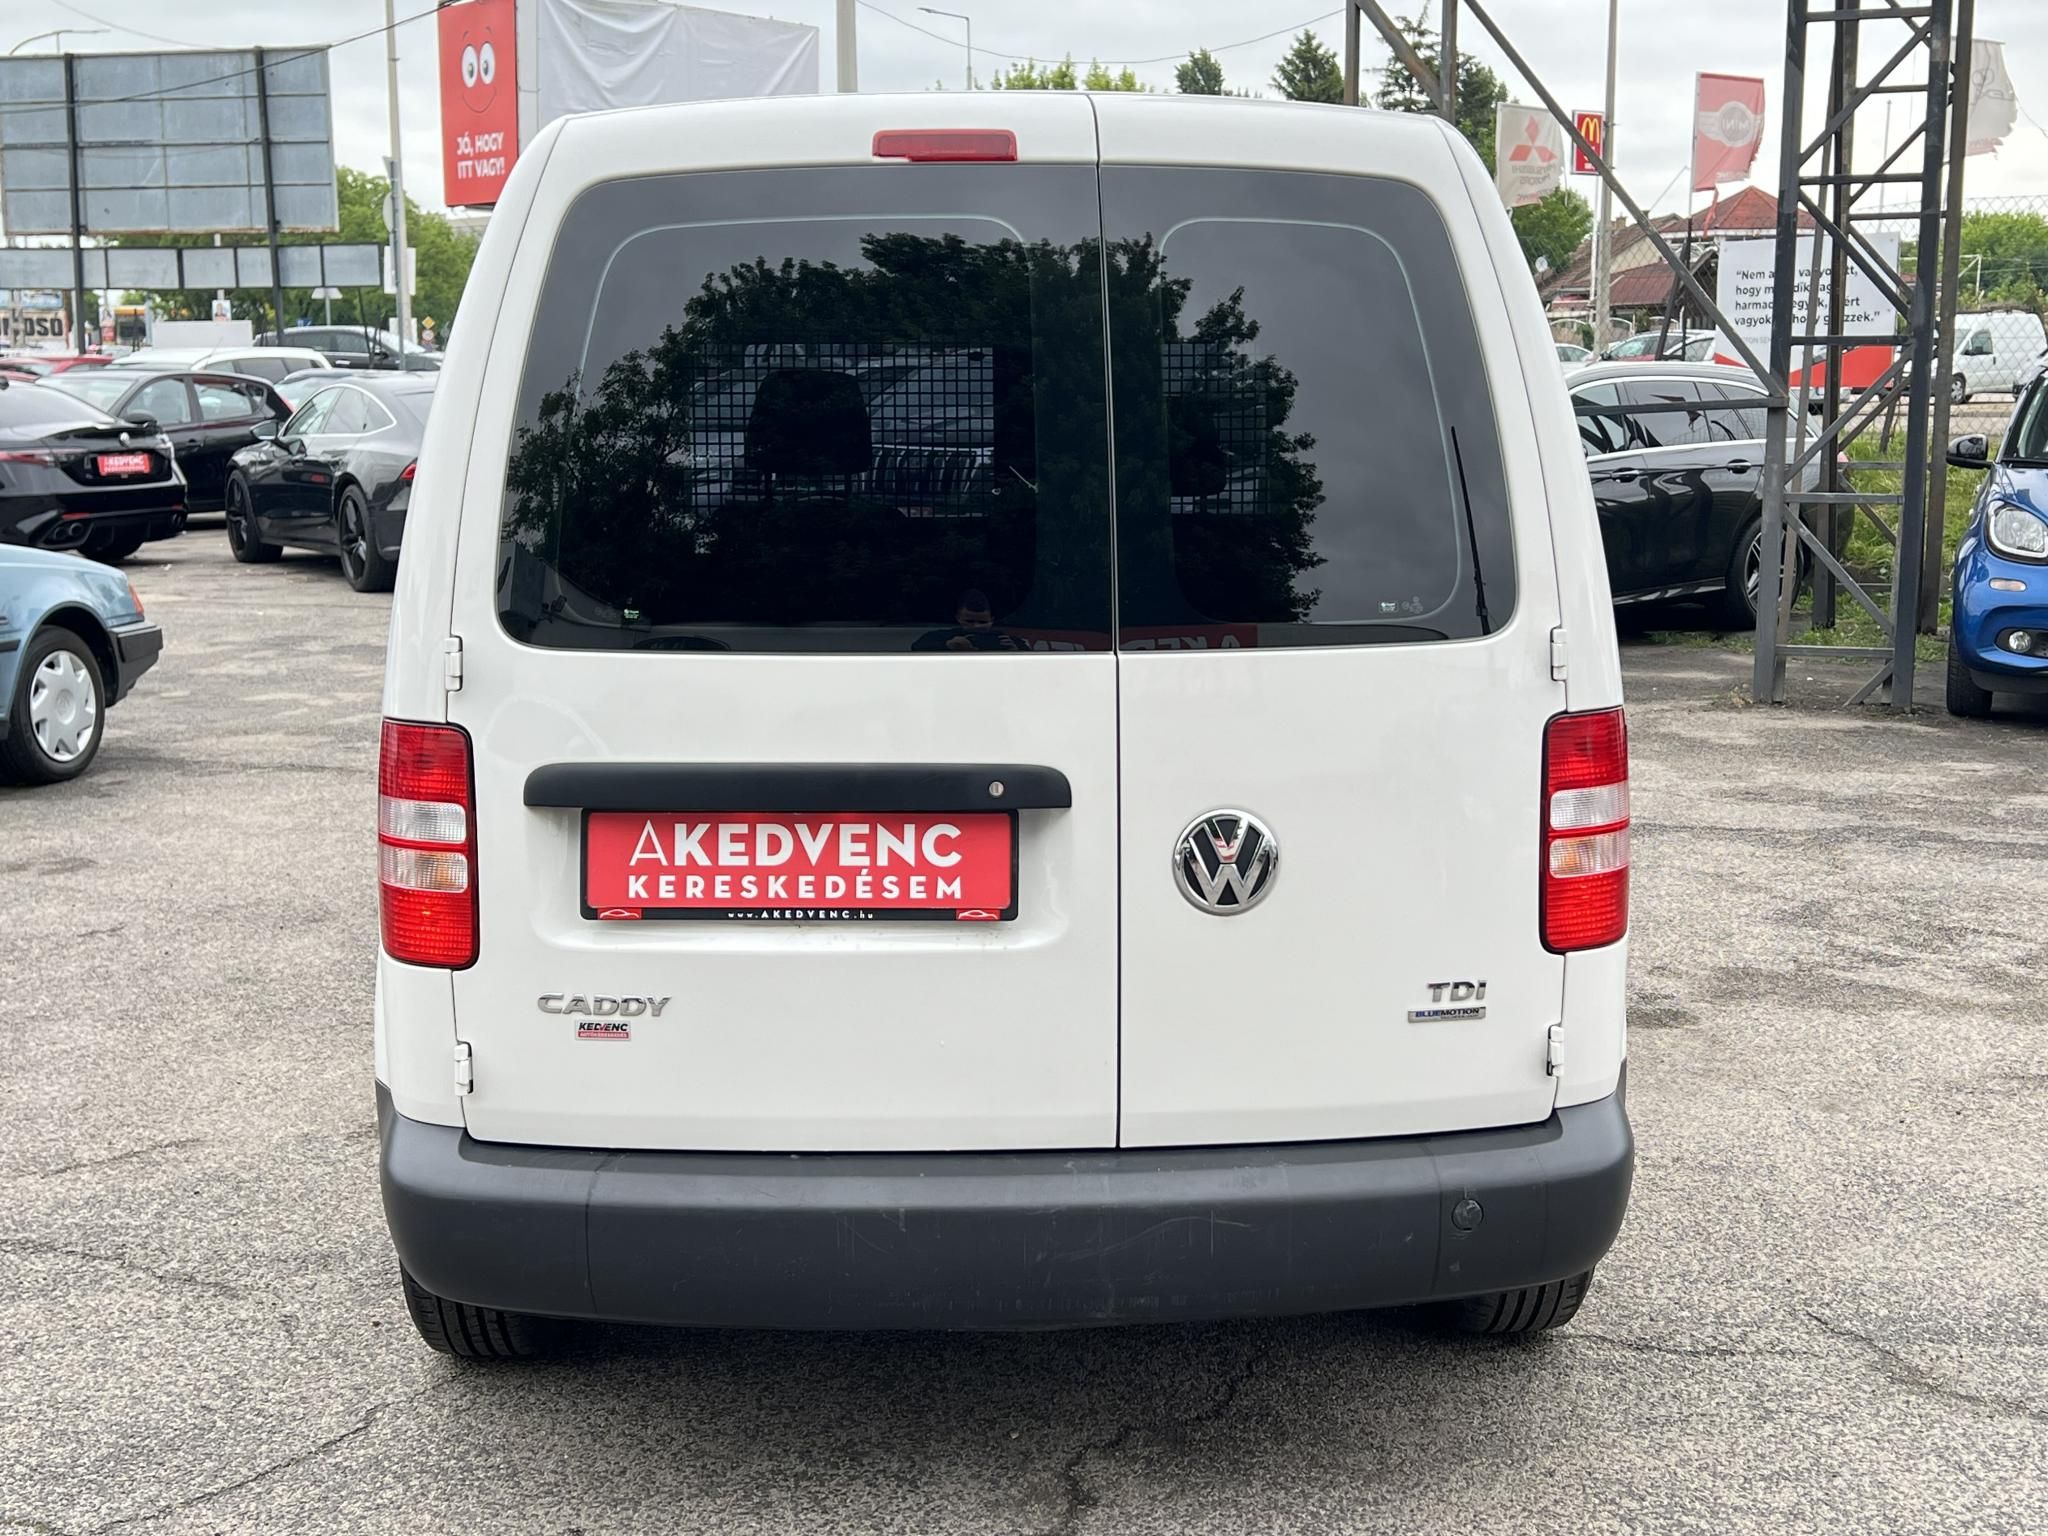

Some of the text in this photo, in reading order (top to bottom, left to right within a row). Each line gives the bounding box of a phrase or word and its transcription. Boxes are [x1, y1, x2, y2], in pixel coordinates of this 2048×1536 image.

[456, 131, 504, 157] JÓ, HOGY
[456, 156, 506, 179] ITT VAGY!
[1735, 284, 1761, 297] hogy
[629, 819, 963, 868] AKEDVENC
[628, 868, 962, 899] KERESKEDÉSEM
[728, 910, 874, 919] www.AKEDVENC.hu
[537, 992, 673, 1017] CADDY
[1415, 1008, 1480, 1018] BLUEMOTION
